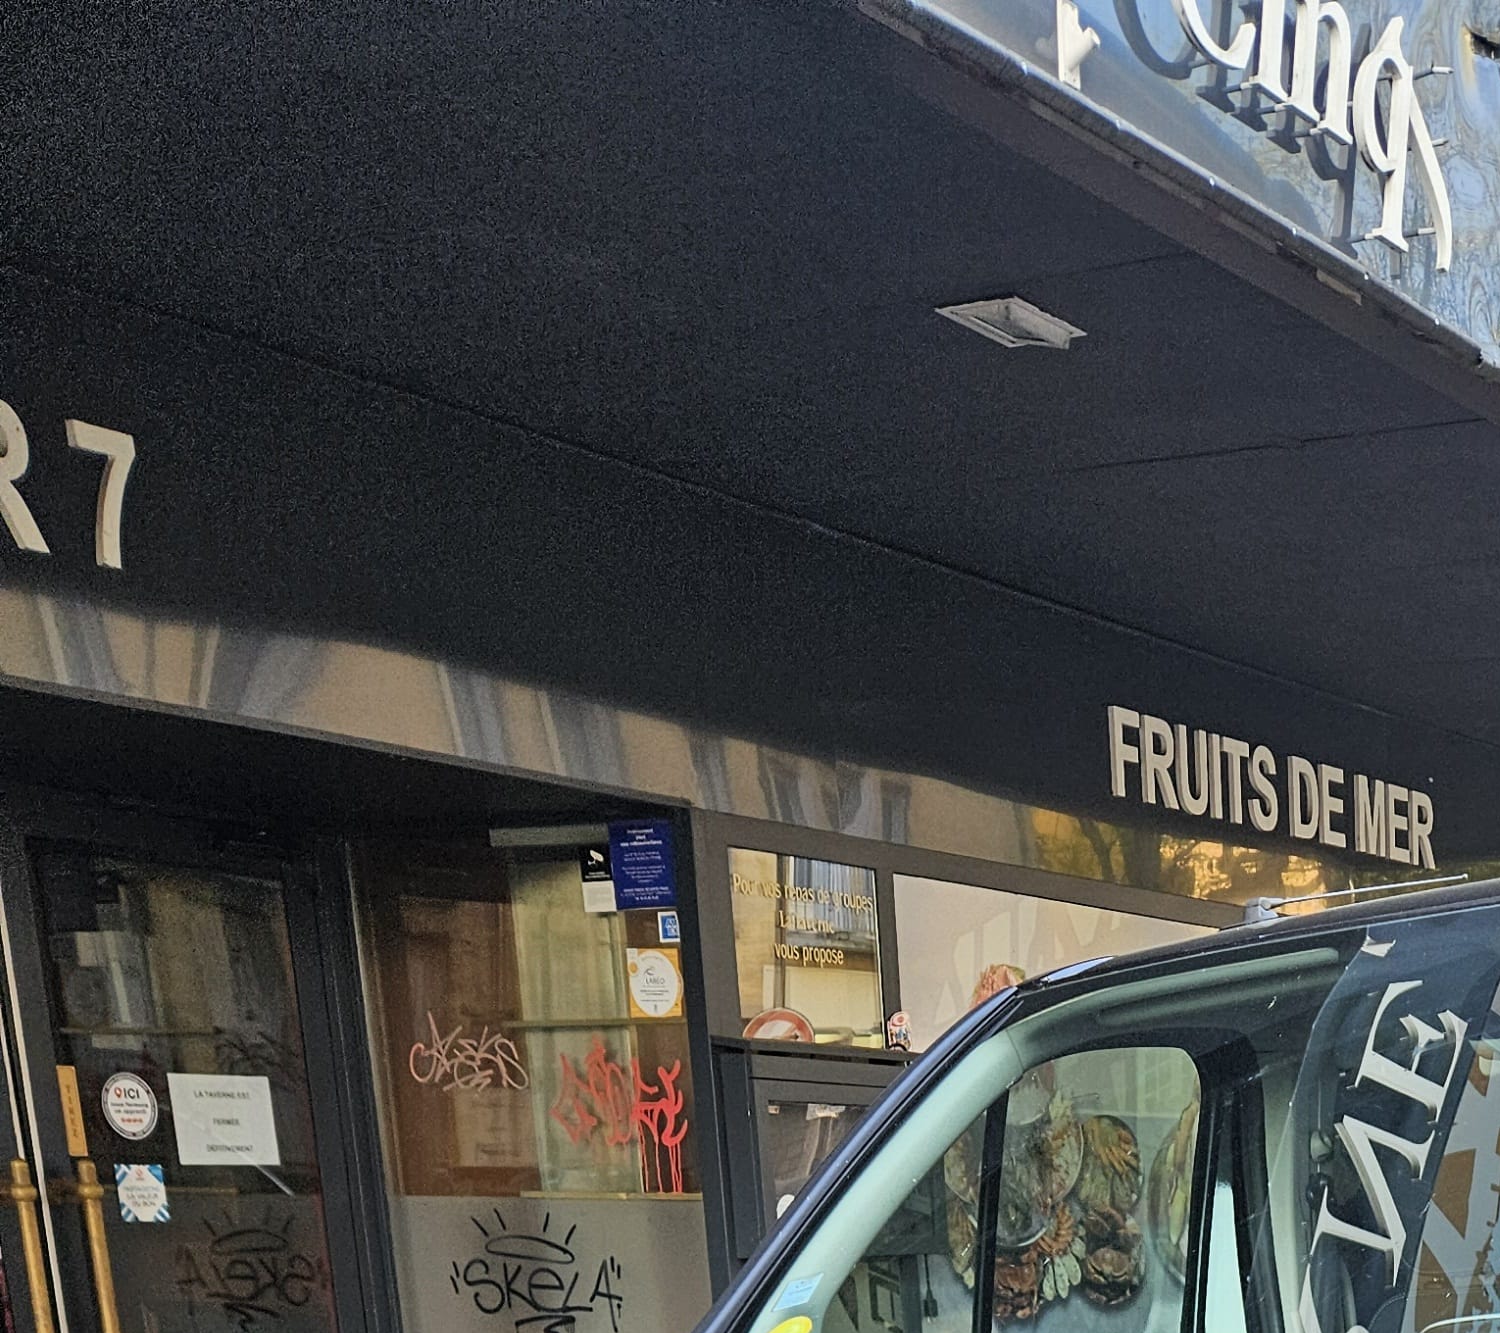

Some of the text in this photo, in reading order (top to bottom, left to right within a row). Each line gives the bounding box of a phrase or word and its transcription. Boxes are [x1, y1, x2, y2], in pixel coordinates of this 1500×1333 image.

[66, 420, 136, 569] 7
[1107, 705, 1436, 870] FRUITS DE MER
[732, 872, 874, 914] Pour vos repas de groupes
[774, 943, 844, 968] vous propose
[123, 1087, 140, 1099] ICI
